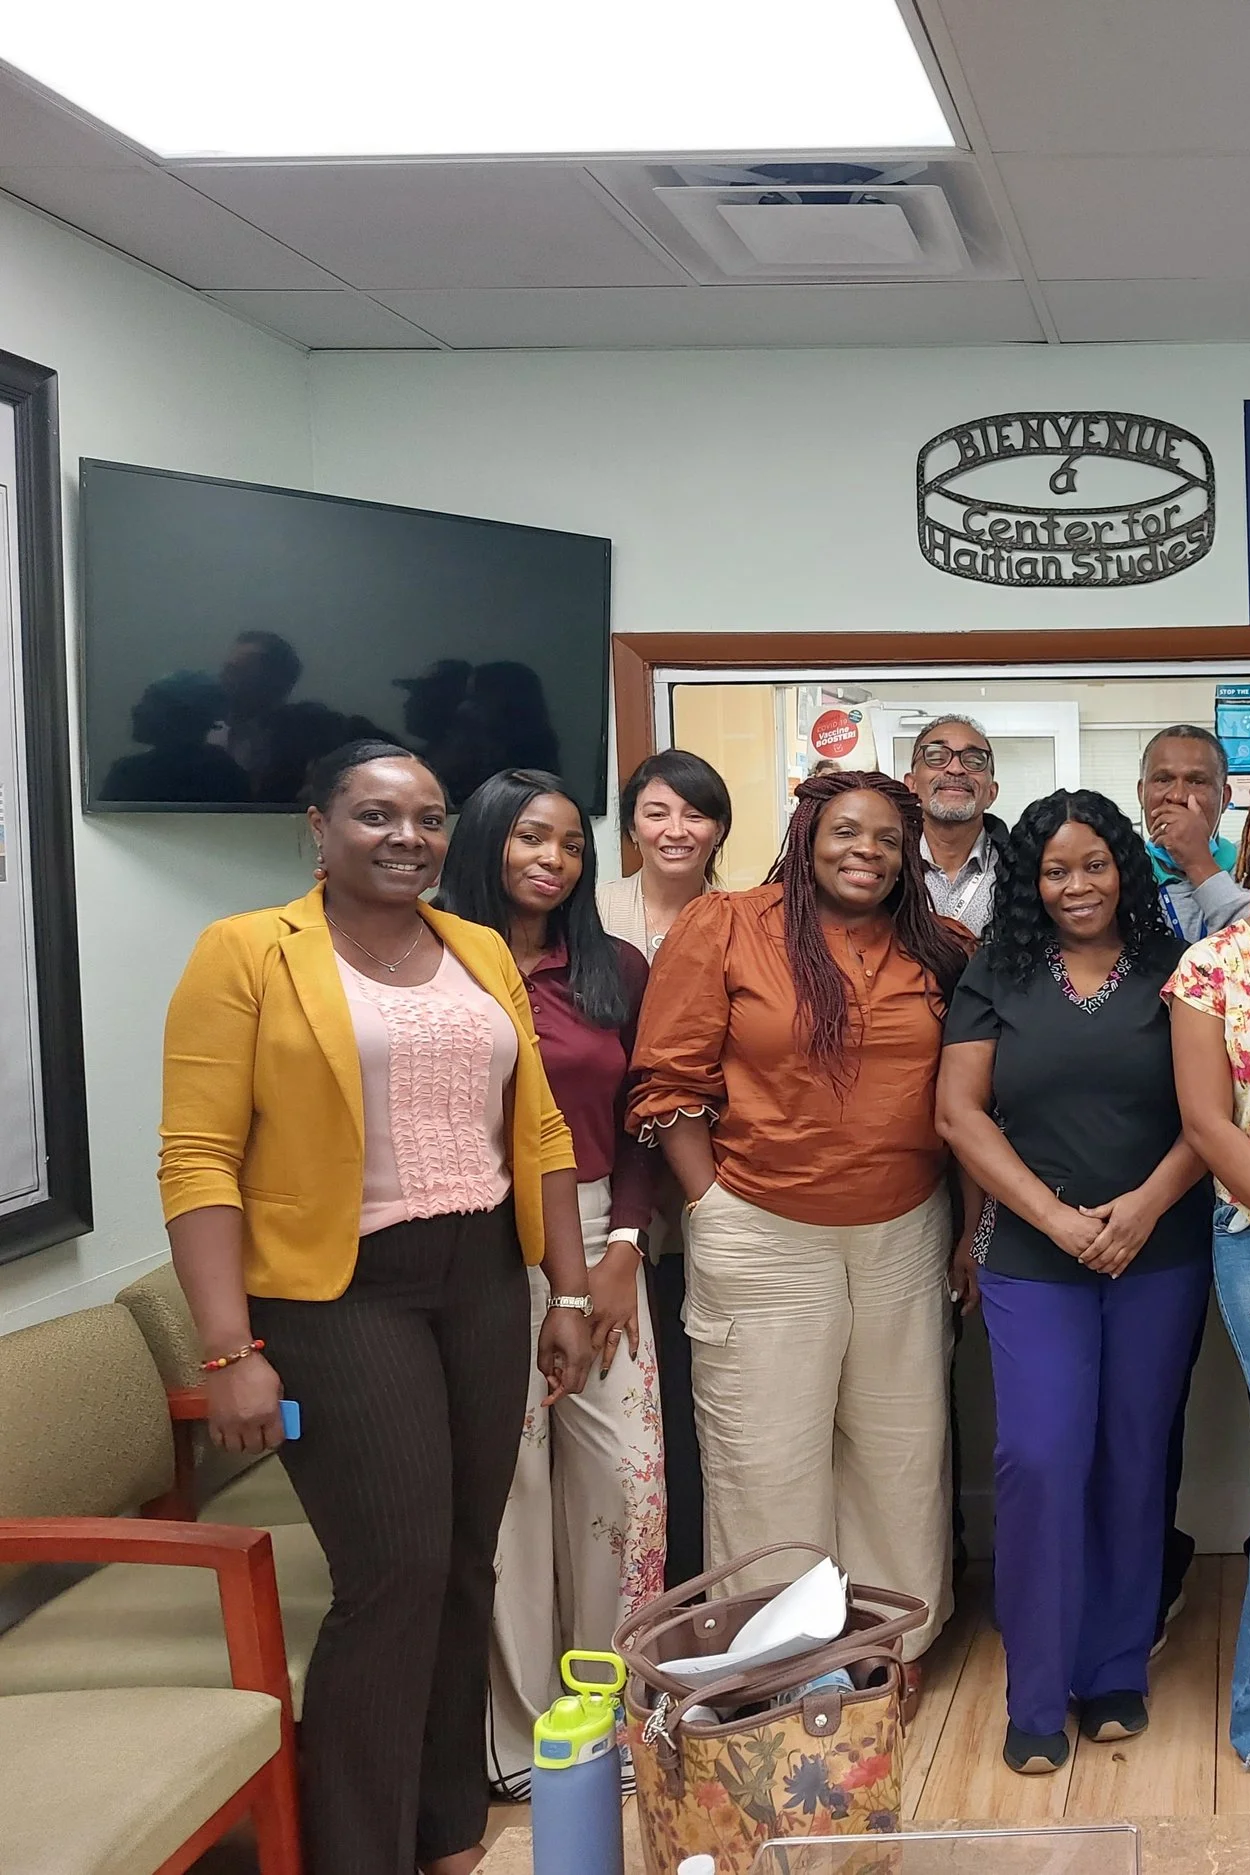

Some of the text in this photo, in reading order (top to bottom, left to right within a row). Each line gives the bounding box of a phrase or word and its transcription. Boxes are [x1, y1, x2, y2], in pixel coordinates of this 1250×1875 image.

[953, 415, 1182, 467] BIENVENUE
[962, 504, 1181, 546] Center for
[928, 523, 1210, 580] Haitian Studies
[1219, 688, 1236, 696] STOP
[1236, 688, 1249, 696] THE
